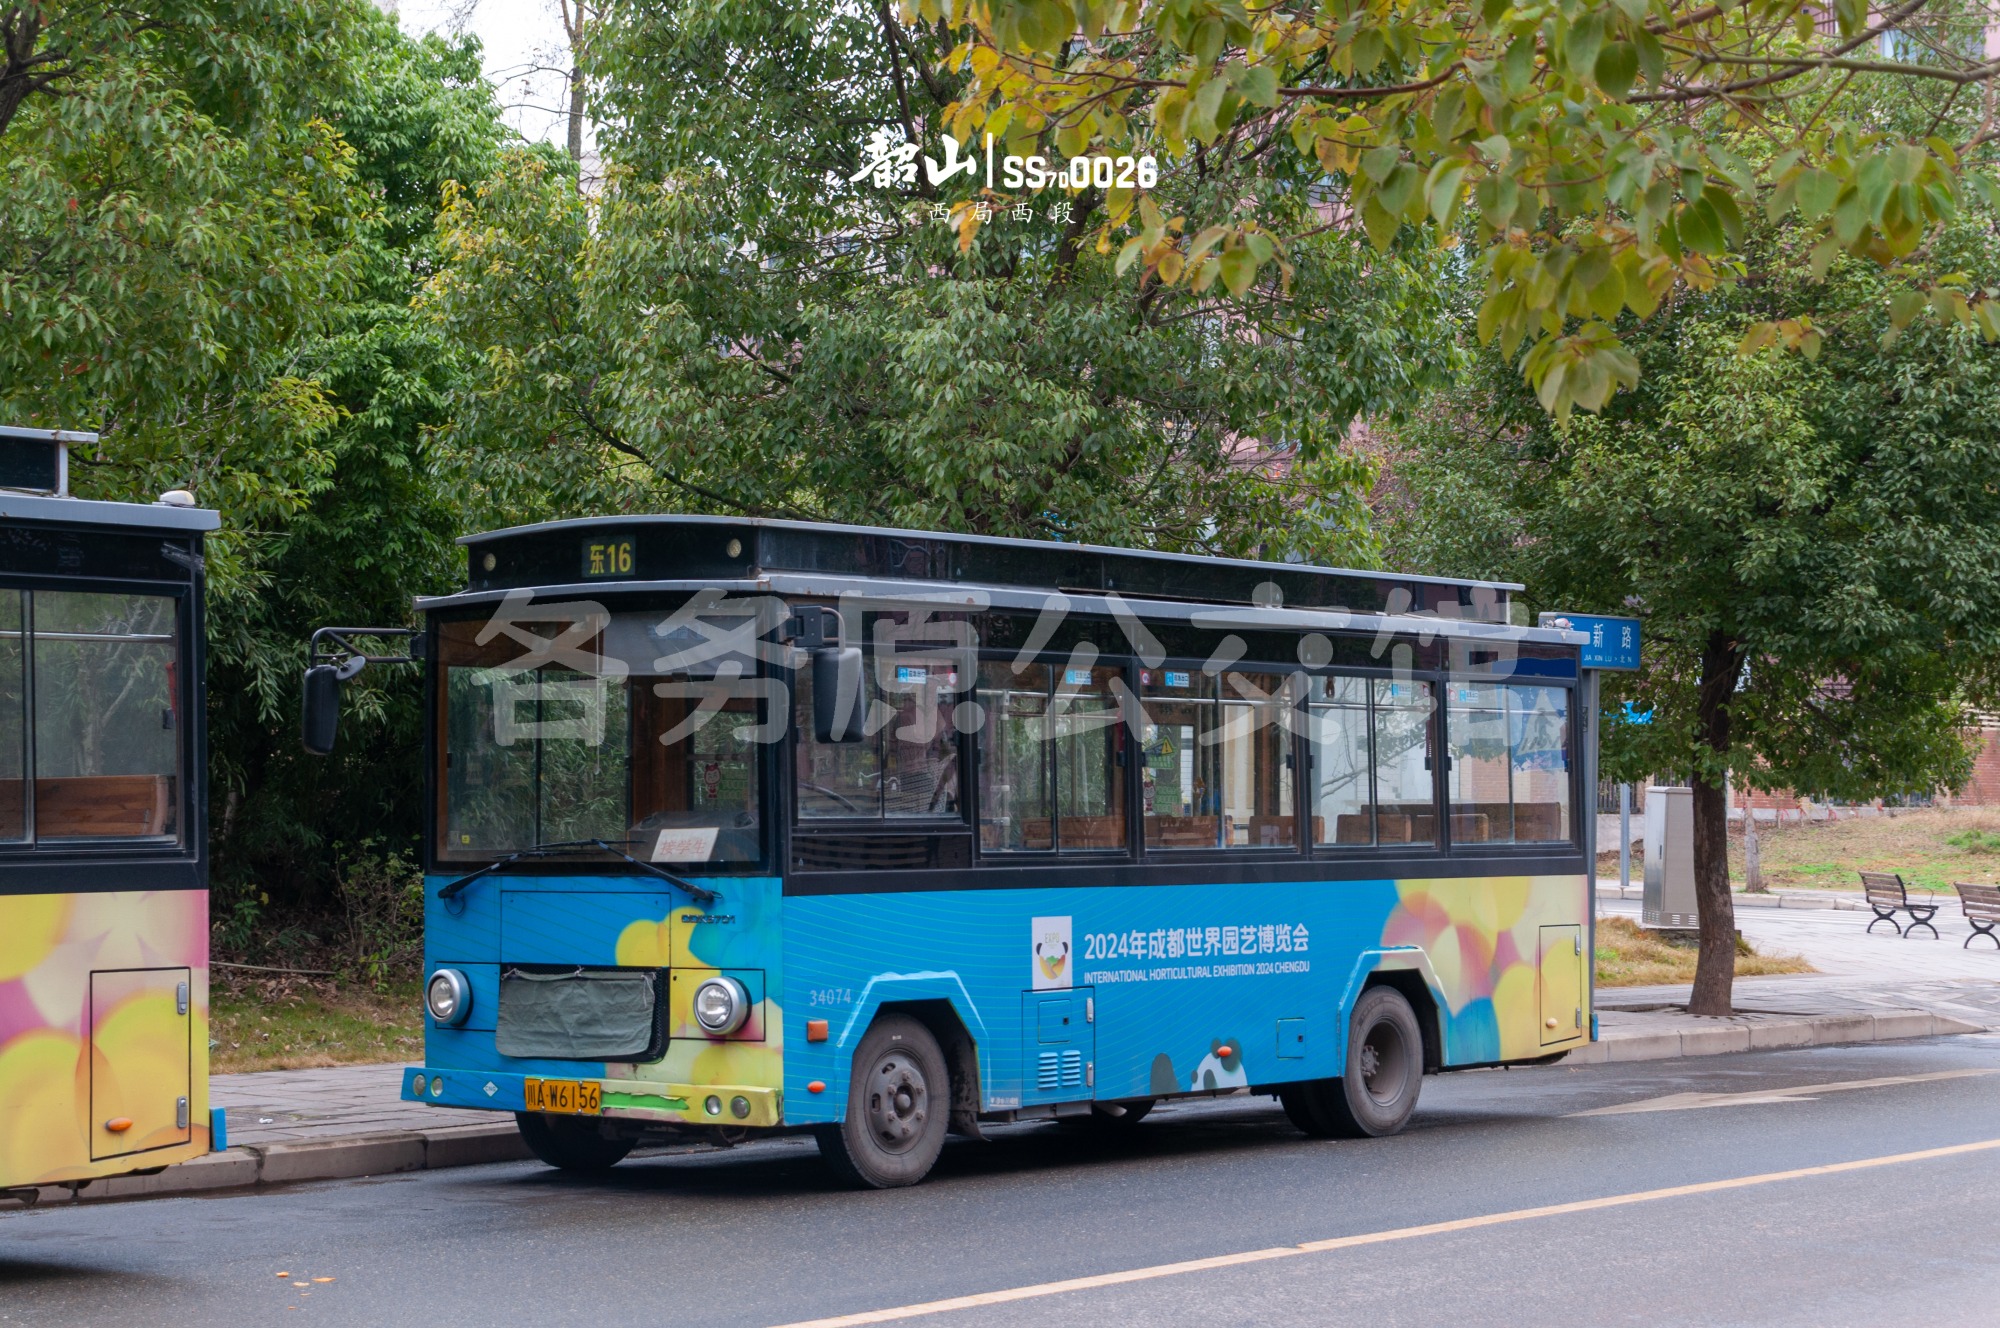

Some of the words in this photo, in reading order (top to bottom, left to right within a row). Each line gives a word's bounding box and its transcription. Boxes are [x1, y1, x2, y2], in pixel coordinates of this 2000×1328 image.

[590, 542, 632, 574] 东16
[660, 838, 707, 856] 接学生
[1084, 922, 1309, 960] 2024年成都世界园艺博览会
[1084, 969, 1148, 984] INTERNATIONAL
[1149, 965, 1212, 980] HORTICULTURAL
[1213, 963, 1255, 977] EXHIBITION
[1256, 962, 1273, 975] 2024
[1274, 960, 1310, 974] CHENGDU
[809, 988, 852, 1006] 34074
